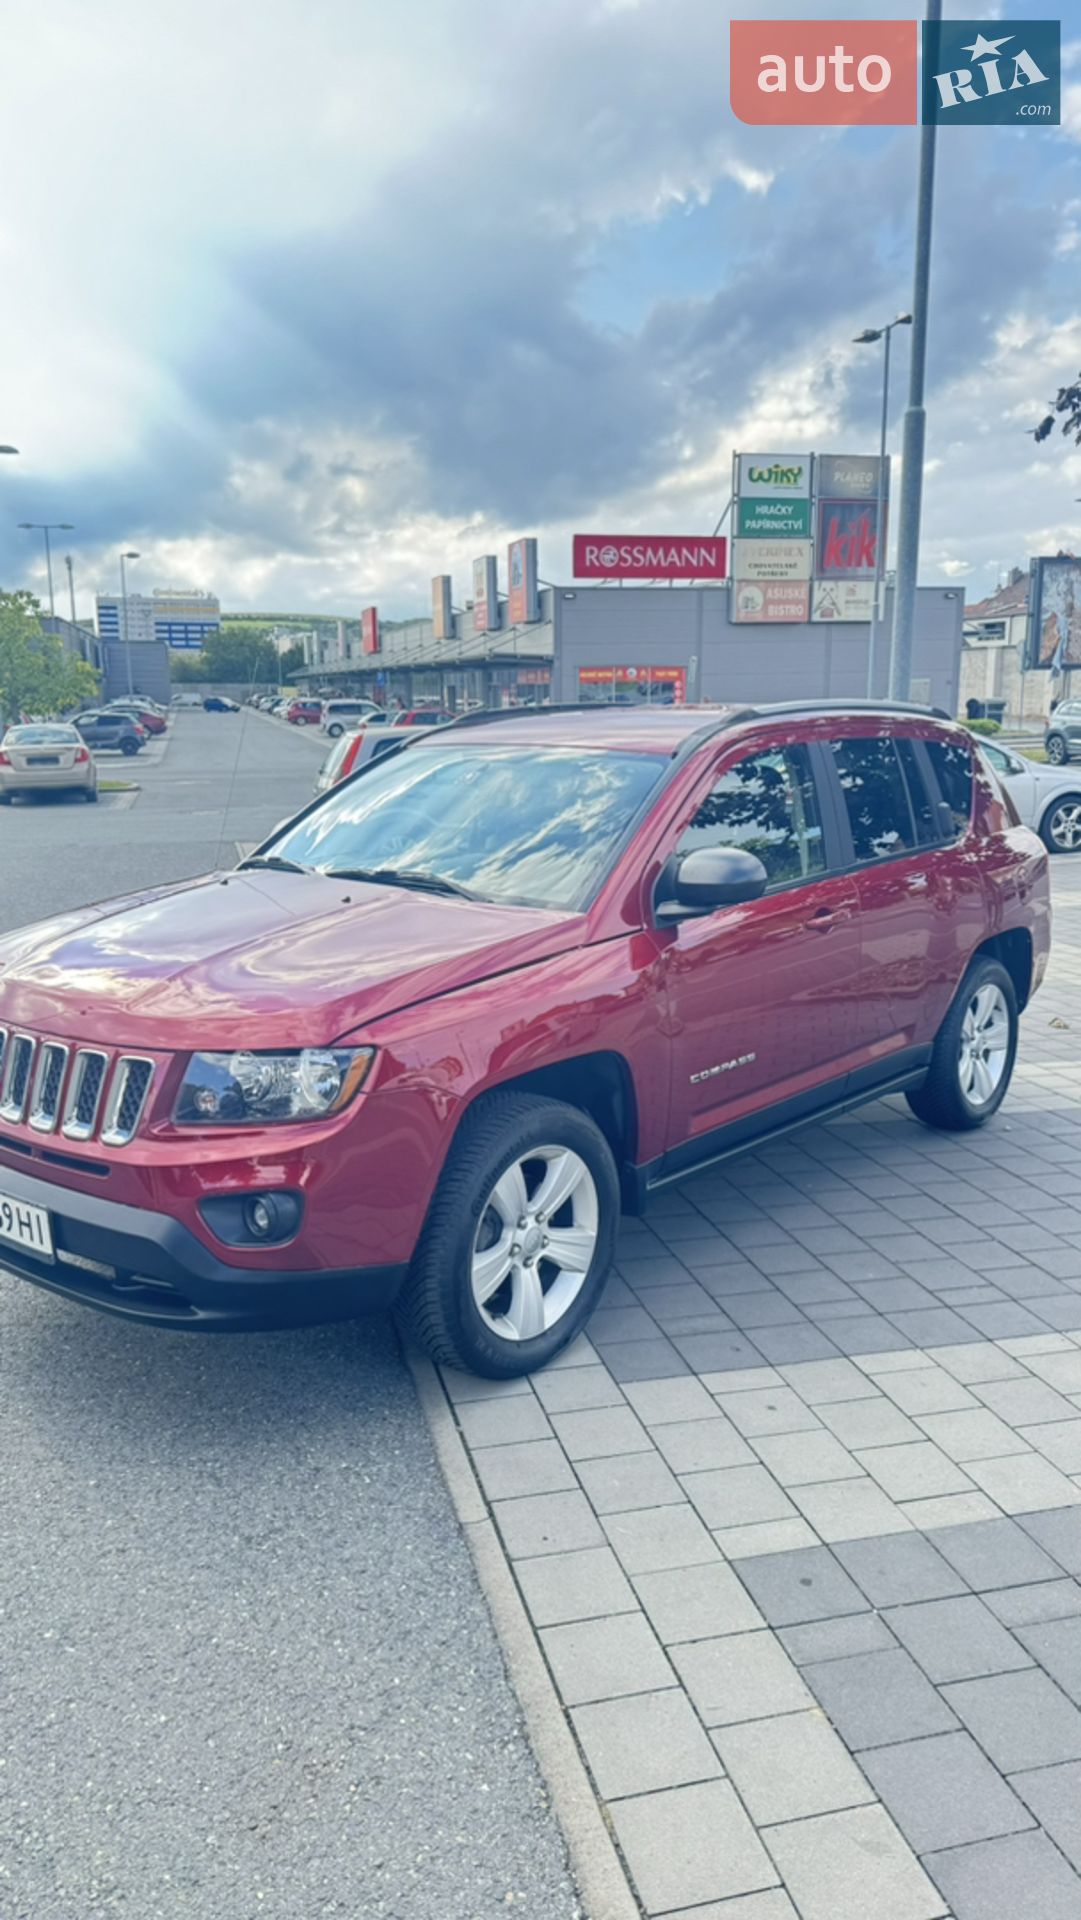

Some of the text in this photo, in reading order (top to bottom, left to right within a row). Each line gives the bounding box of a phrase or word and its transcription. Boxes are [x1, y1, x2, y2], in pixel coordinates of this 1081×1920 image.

[833, 471, 873, 482] PLANEO
[755, 504, 794, 515] HRAČKY
[744, 518, 803, 531] PAPÍRNICTVÍ
[824, 516, 878, 569] kik
[585, 545, 717, 568] ROSSMANN
[767, 604, 805, 617] BISTRO
[689, 1052, 756, 1084] COMPASS
[0, 1201, 44, 1246] 9HI
